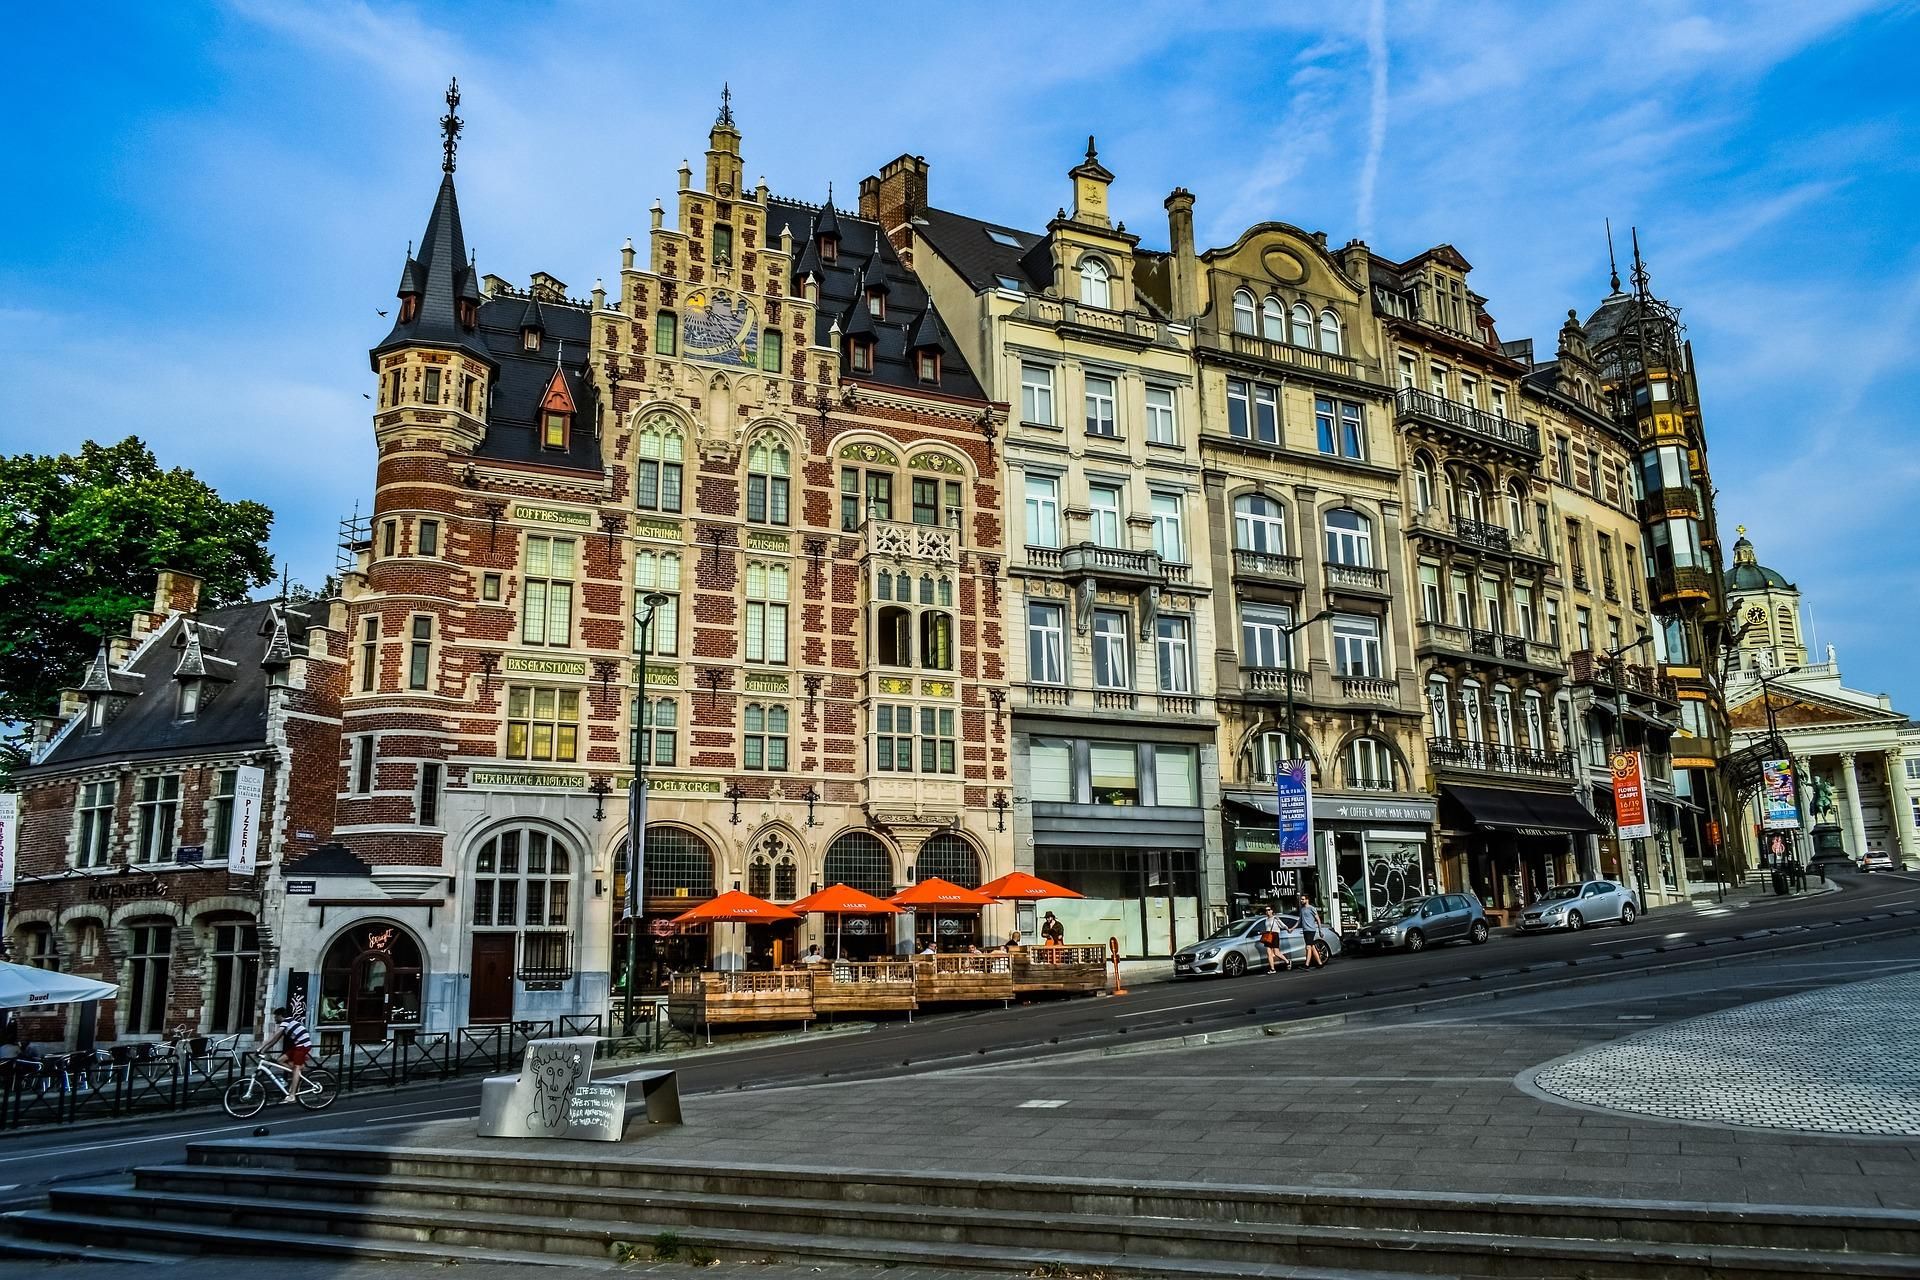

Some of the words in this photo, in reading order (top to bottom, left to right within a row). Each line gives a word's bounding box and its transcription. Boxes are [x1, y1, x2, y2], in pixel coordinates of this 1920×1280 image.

[516, 507, 559, 522] COFFRES
[632, 672, 678, 686] BNDAGES
[745, 680, 788, 693] CEINTURES
[474, 773, 533, 786] PHARMACIE
[535, 775, 584, 788] ANGLAISE
[653, 780, 710, 793] DELACRE
[1620, 800, 1640, 809] 16/19
[1349, 806, 1368, 818] COFFEE
[1369, 808, 1374, 817] &
[1404, 808, 1419, 819] DAILY
[1419, 809, 1432, 820] FOOD
[239, 799, 252, 864] PIZZERIA
[1270, 870, 1296, 886] LOVE
[29, 992, 50, 1002] Duvel
